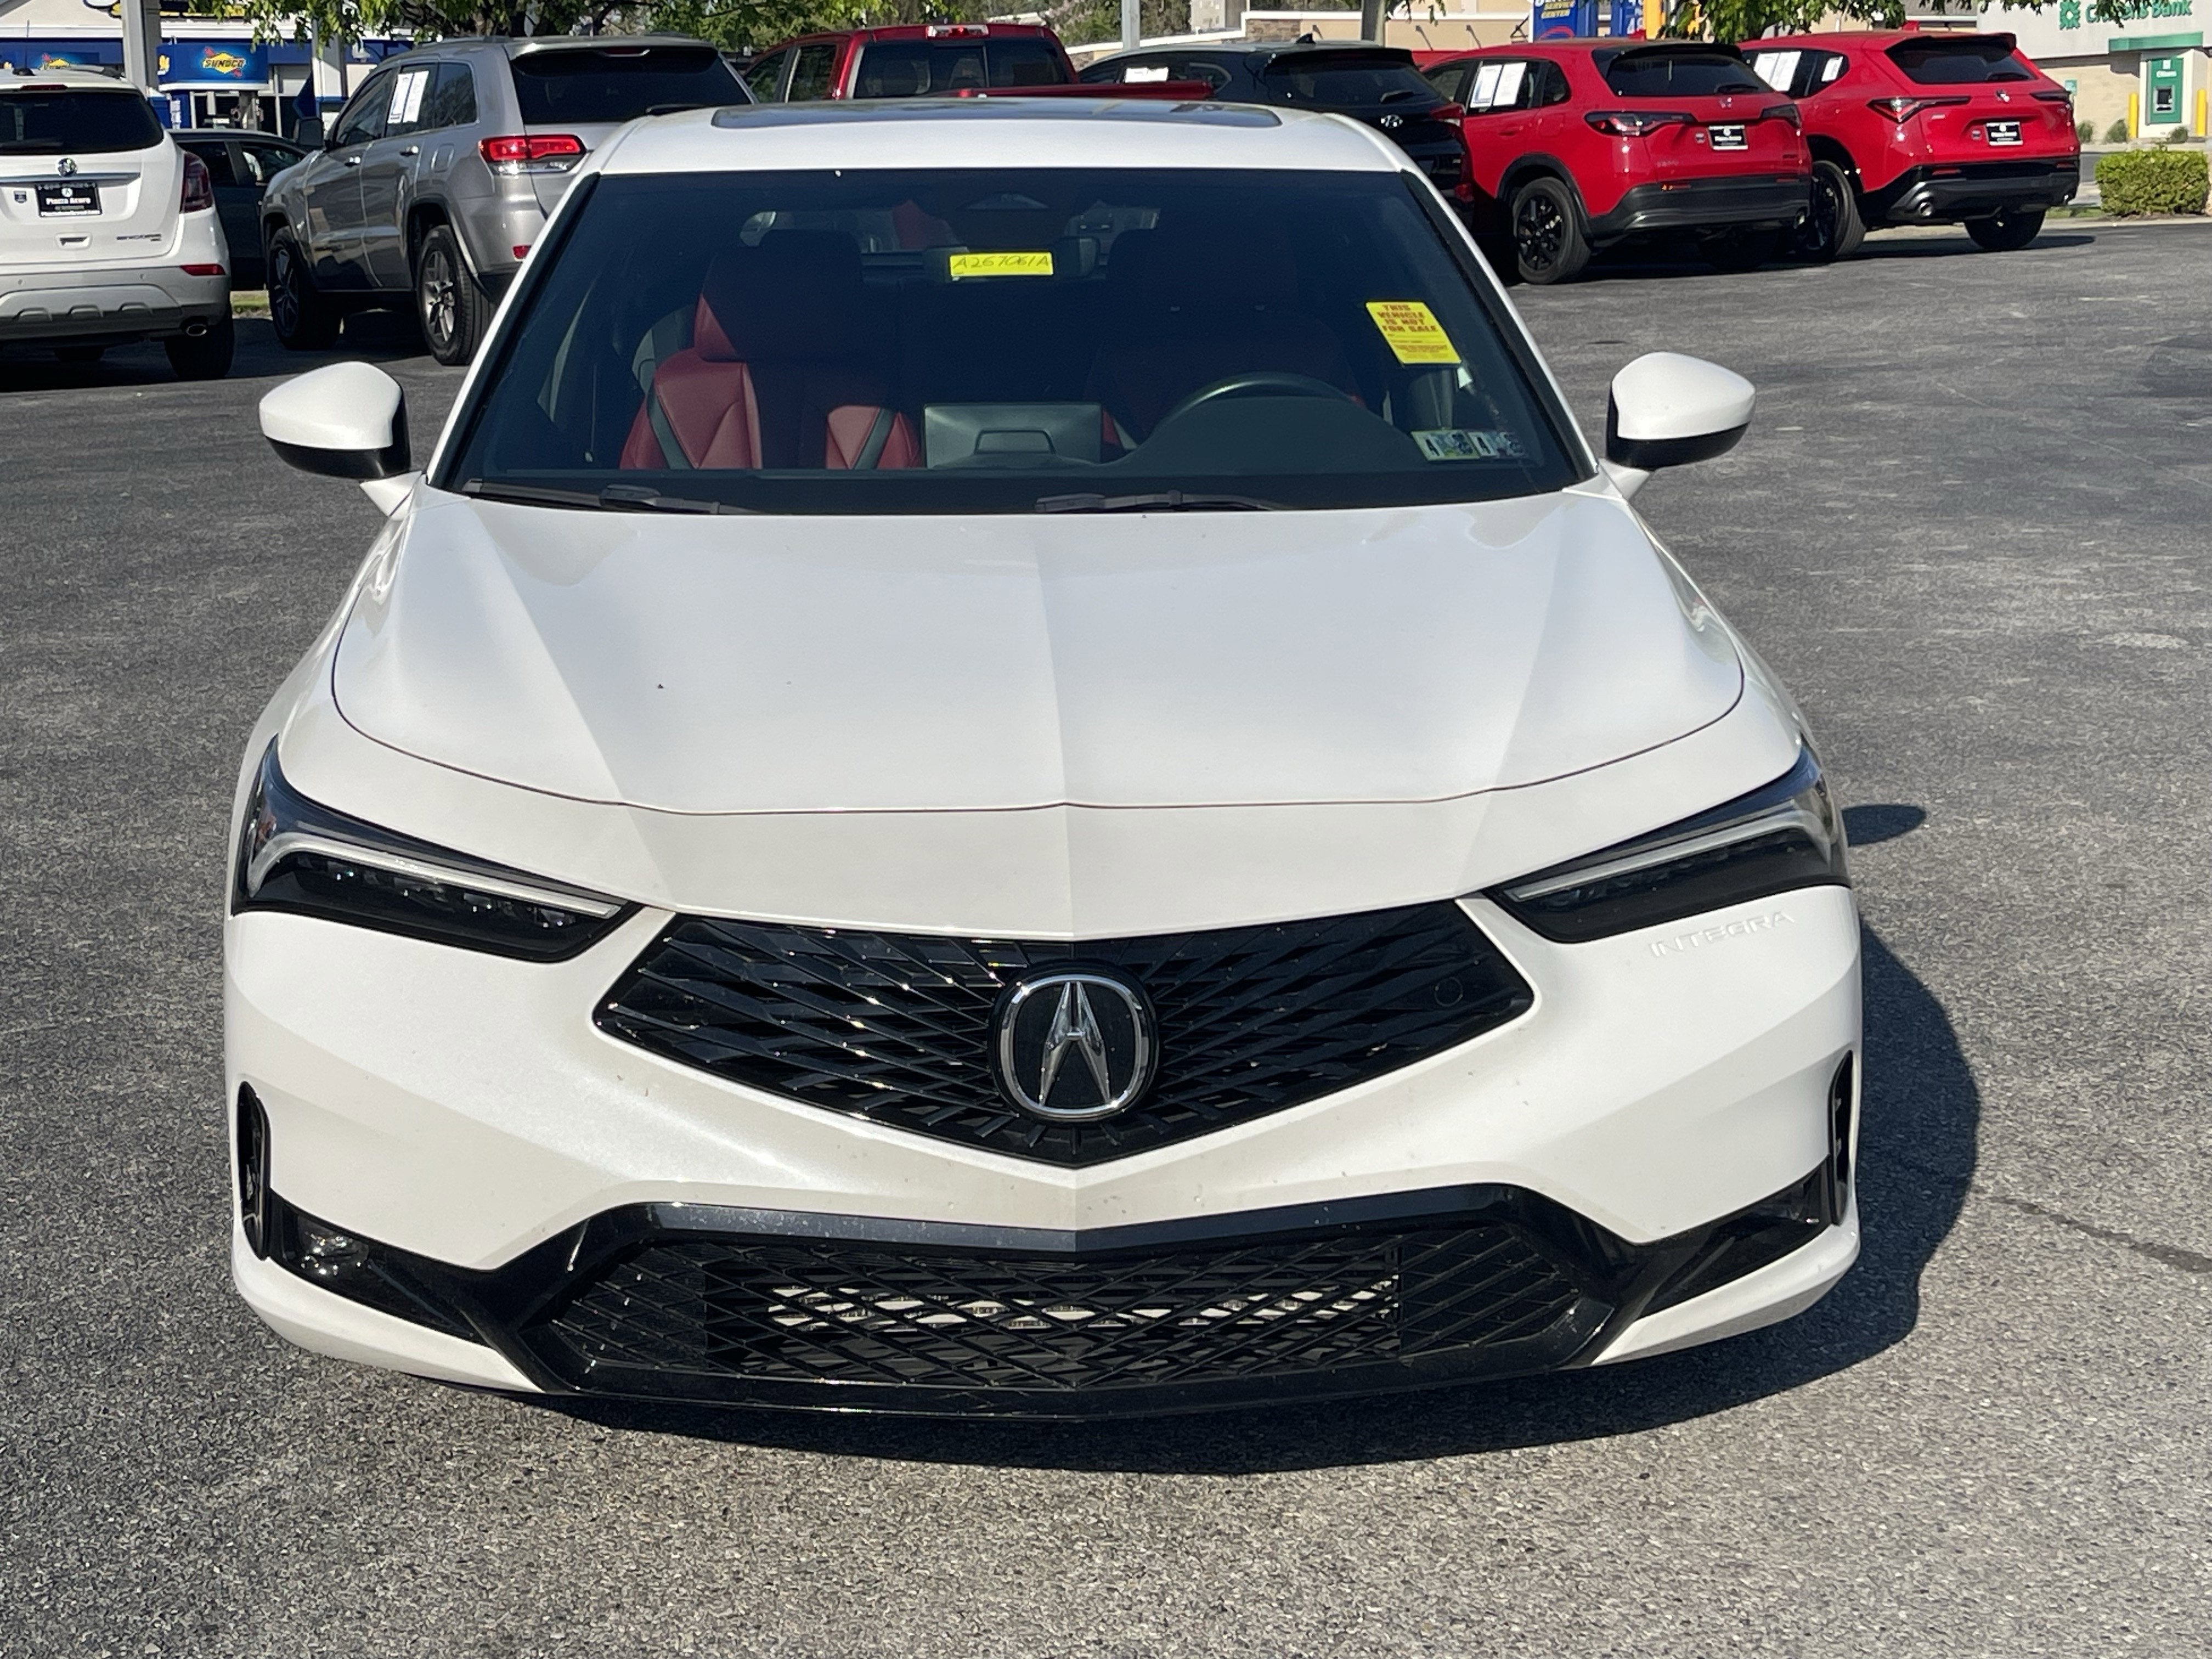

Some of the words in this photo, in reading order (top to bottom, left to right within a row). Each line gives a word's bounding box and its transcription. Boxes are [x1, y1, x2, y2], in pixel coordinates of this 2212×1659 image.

[2152, 0, 2192, 18] Bank
[204, 58, 245, 68] SUNOCO
[1648, 911, 1796, 957] INTEGRA
